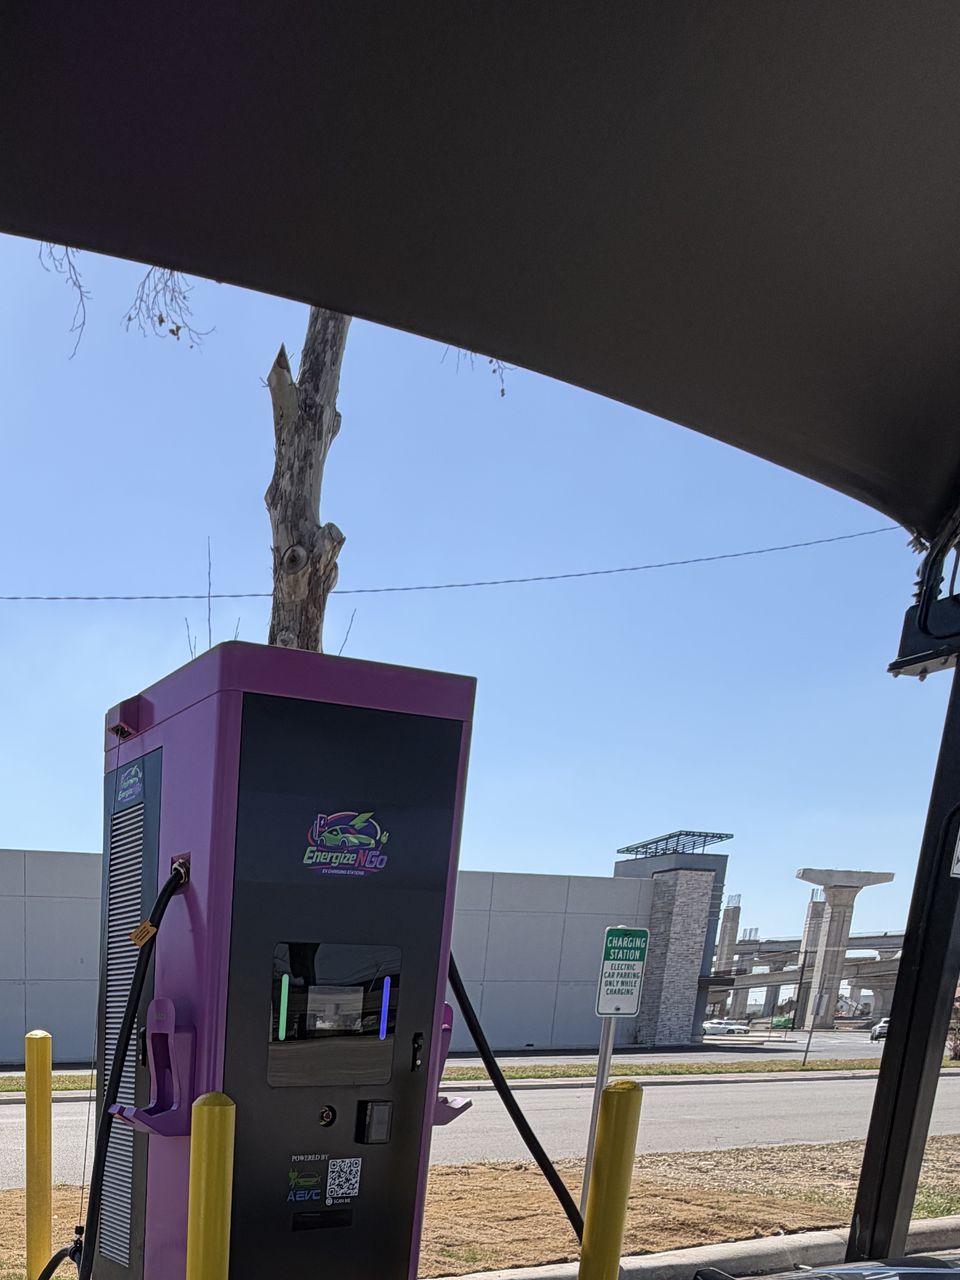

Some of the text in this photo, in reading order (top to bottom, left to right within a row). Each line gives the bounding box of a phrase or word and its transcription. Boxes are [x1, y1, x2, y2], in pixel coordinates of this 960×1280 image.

[607, 936, 646, 948] CHARGING
[609, 949, 640, 960] STATION
[610, 963, 636, 971] ELECTRIC
[603, 971, 640, 979] CAR PARKING
[620, 980, 637, 988] WHILE
[605, 988, 634, 996] CHARGING
[291, 1154, 320, 1162] POWERED
